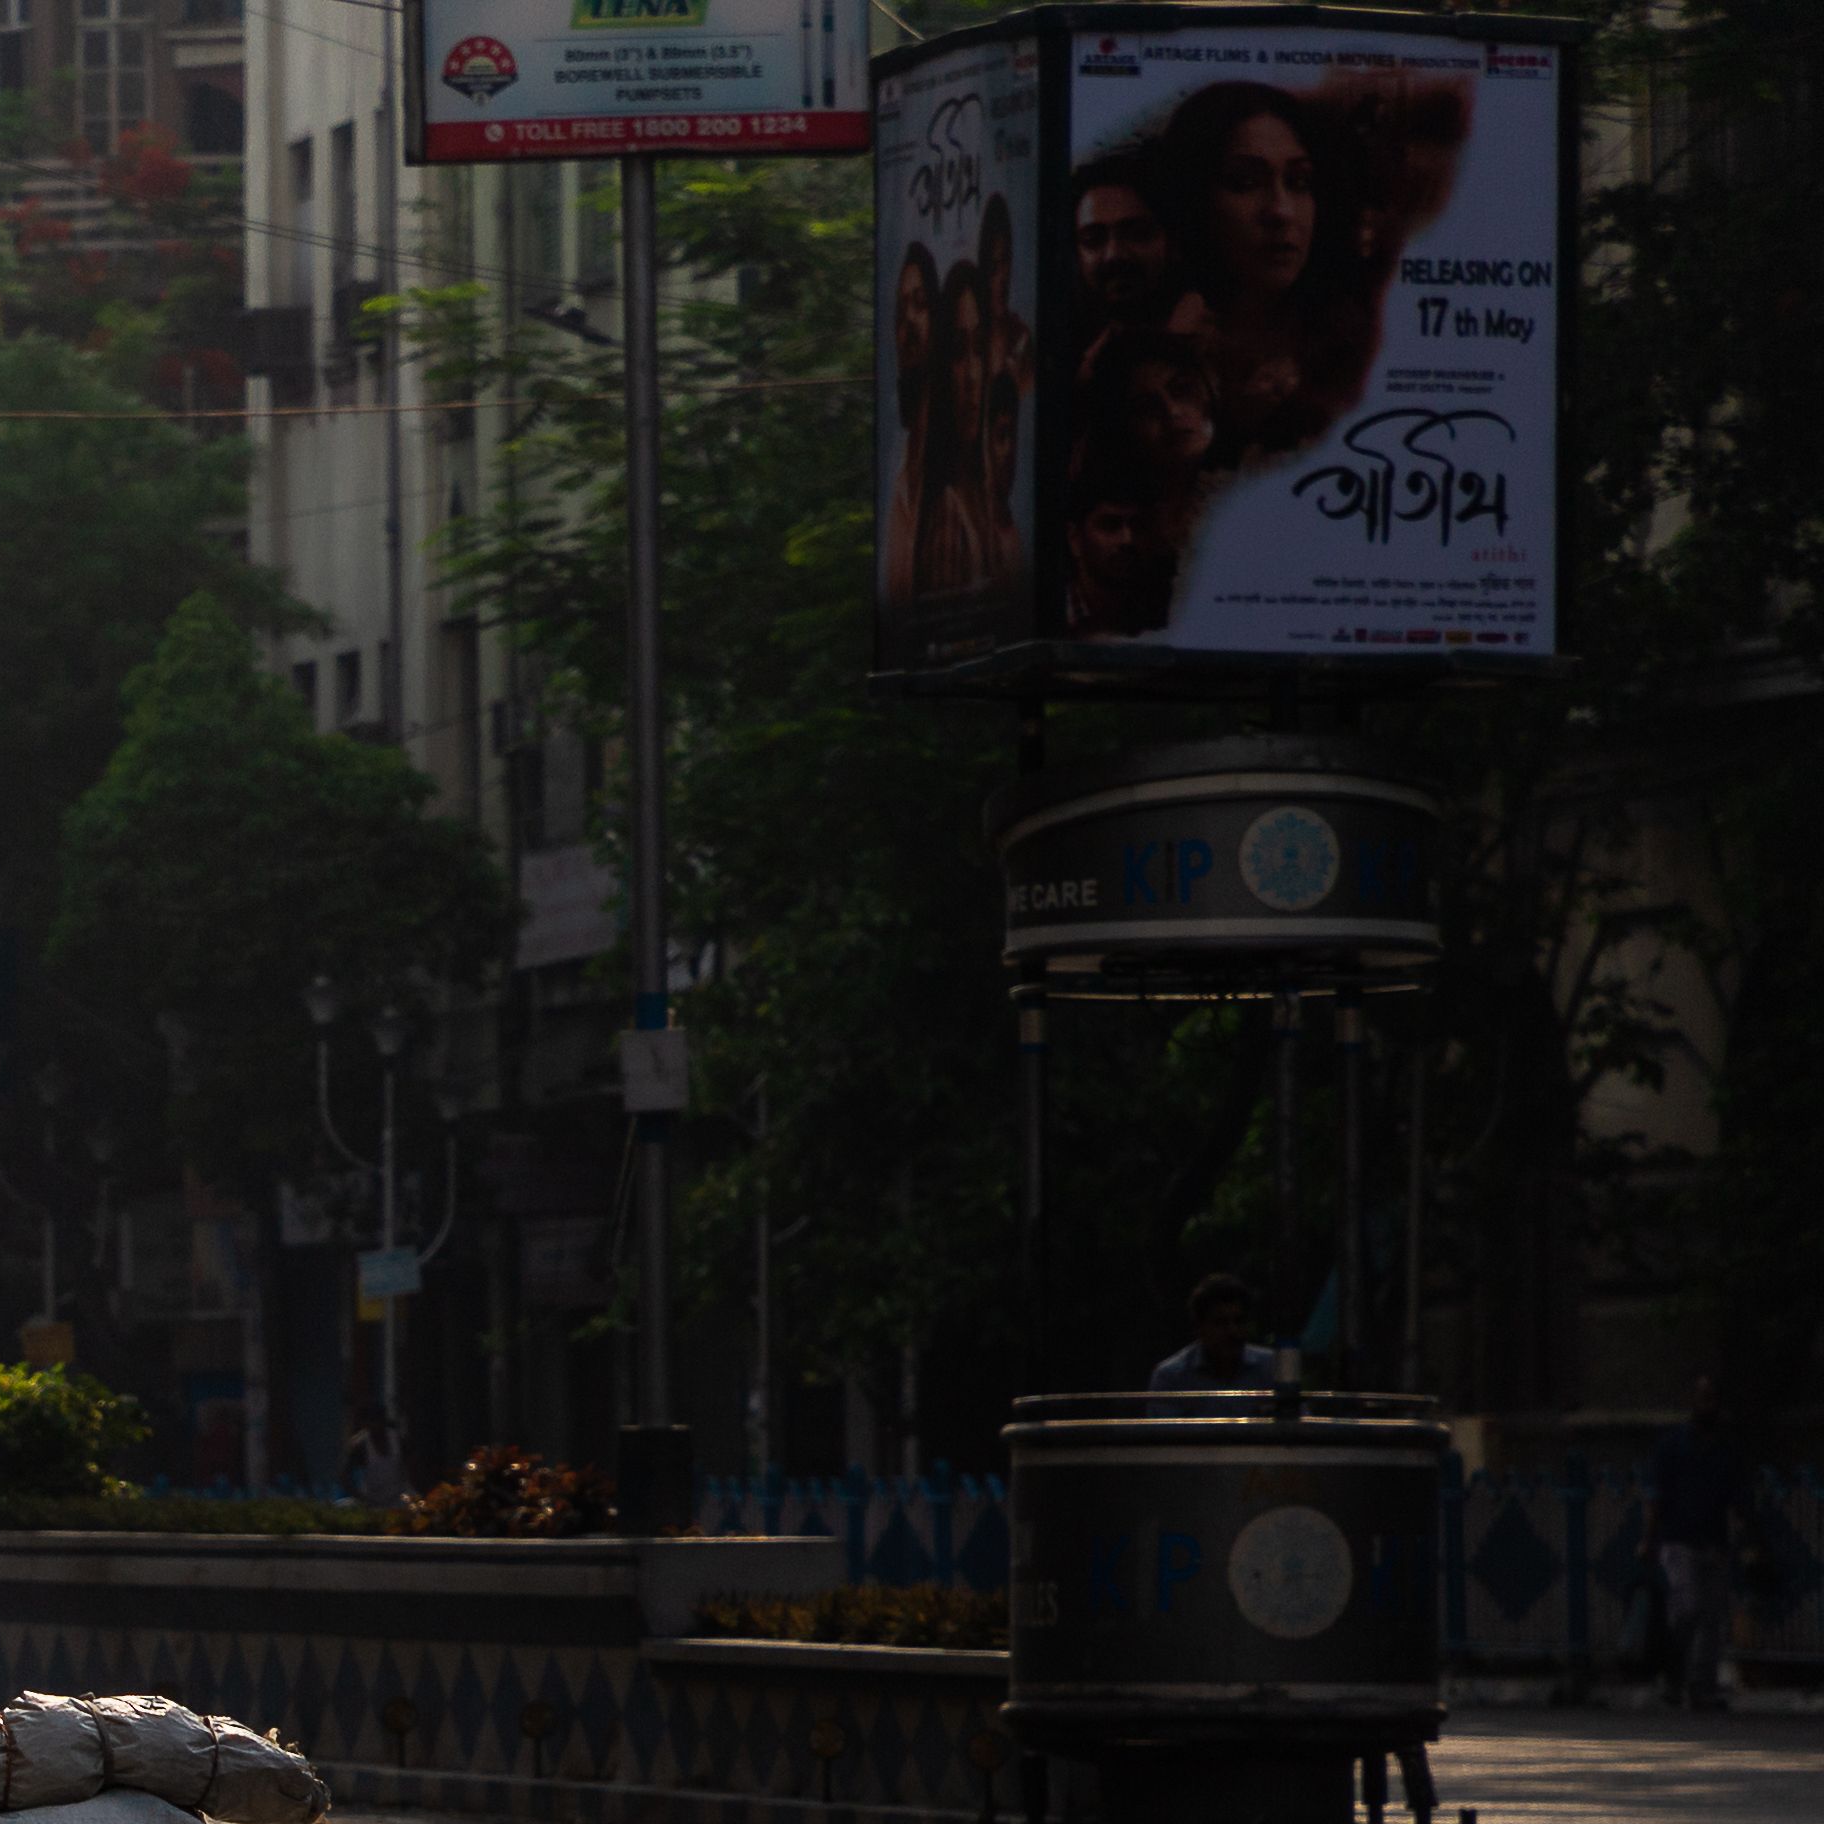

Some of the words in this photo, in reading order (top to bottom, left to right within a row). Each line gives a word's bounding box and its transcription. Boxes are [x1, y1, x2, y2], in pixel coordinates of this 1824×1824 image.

[515, 123, 568, 141] TOLL
[571, 120, 626, 139] FREE
[633, 117, 690, 137] 1800
[696, 117, 742, 136] 200
[750, 114, 809, 134] 1234
[1403, 258, 1513, 287] RELEASING
[1518, 261, 1551, 287] ON
[1417, 297, 1450, 338] 17
[1454, 307, 1479, 338] th
[1485, 308, 1536, 345] May
[1032, 879, 1098, 910] CARE
